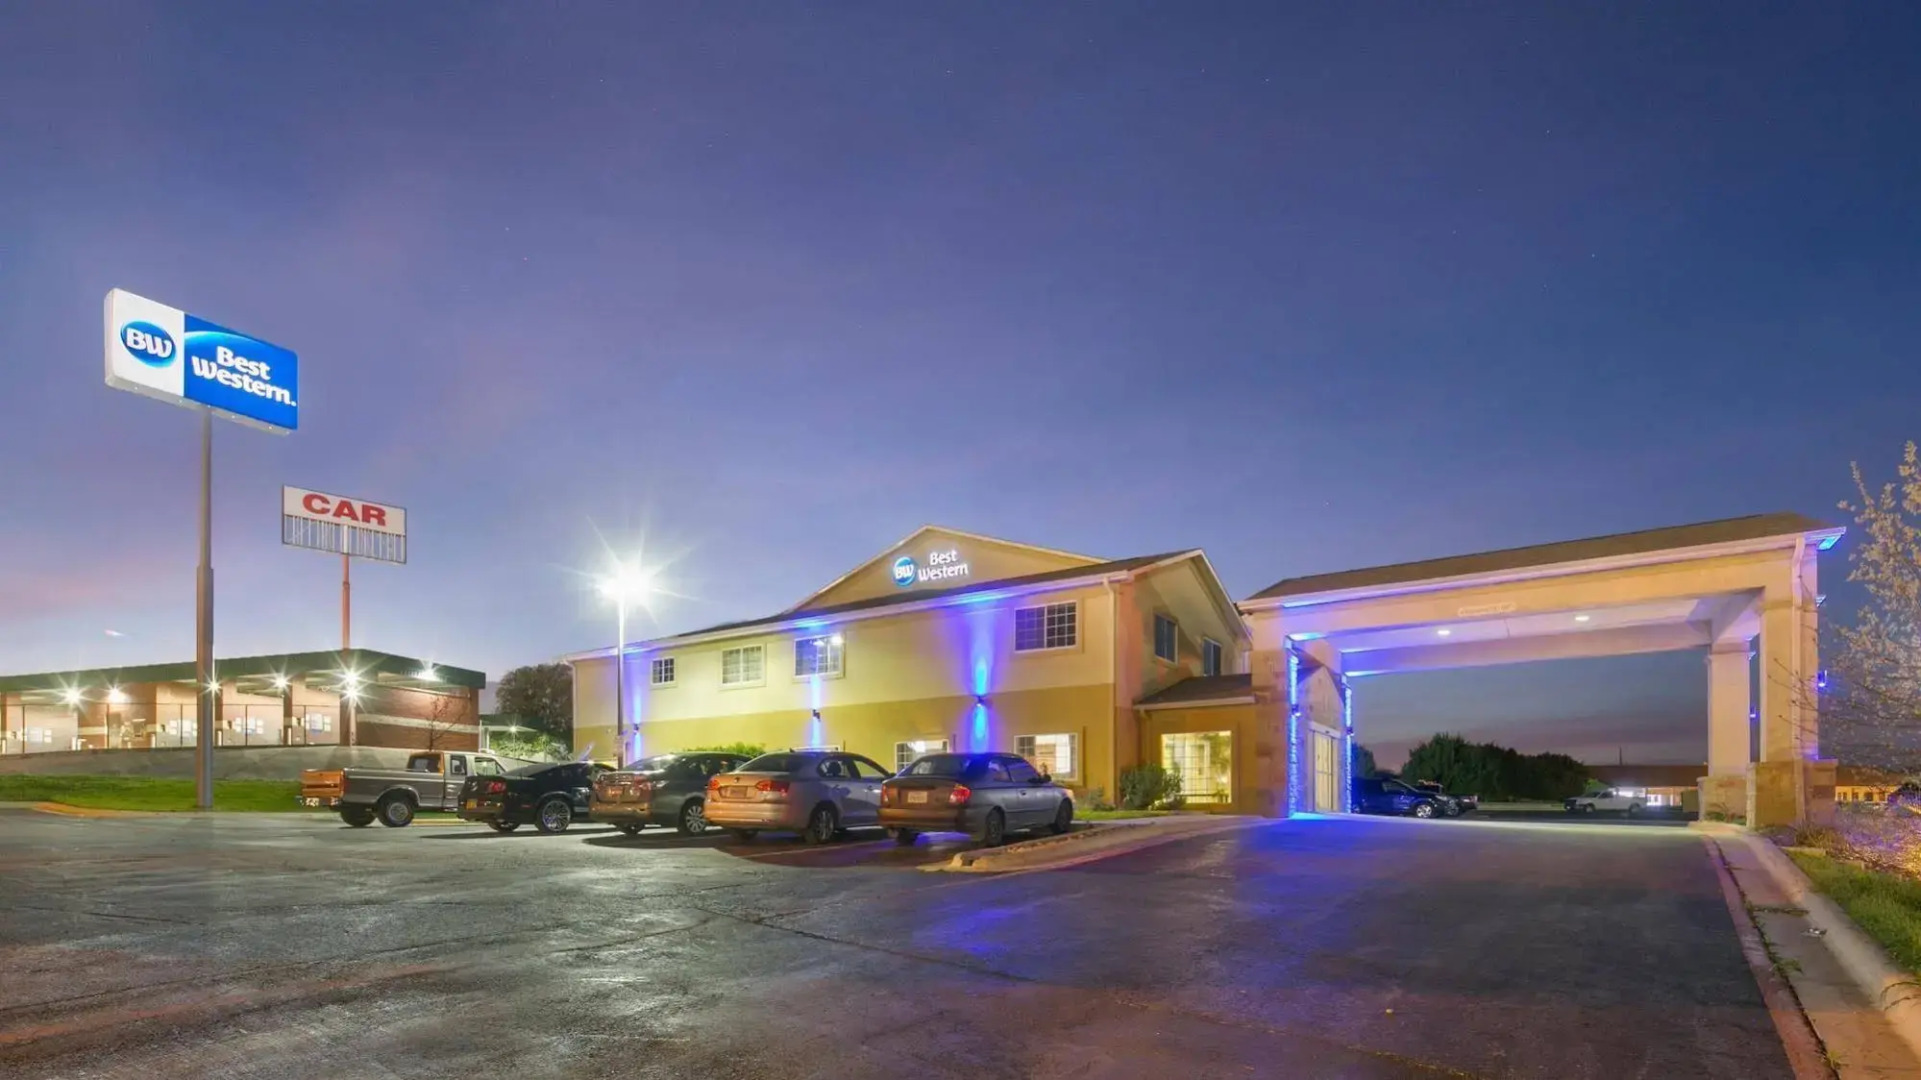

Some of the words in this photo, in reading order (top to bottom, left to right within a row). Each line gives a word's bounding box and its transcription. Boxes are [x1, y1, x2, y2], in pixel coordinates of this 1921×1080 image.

[126, 328, 173, 358] BW
[216, 345, 275, 380] Best
[302, 493, 387, 527] CAR
[929, 549, 957, 566] Best
[894, 563, 915, 579] BW
[917, 563, 969, 582] Western
